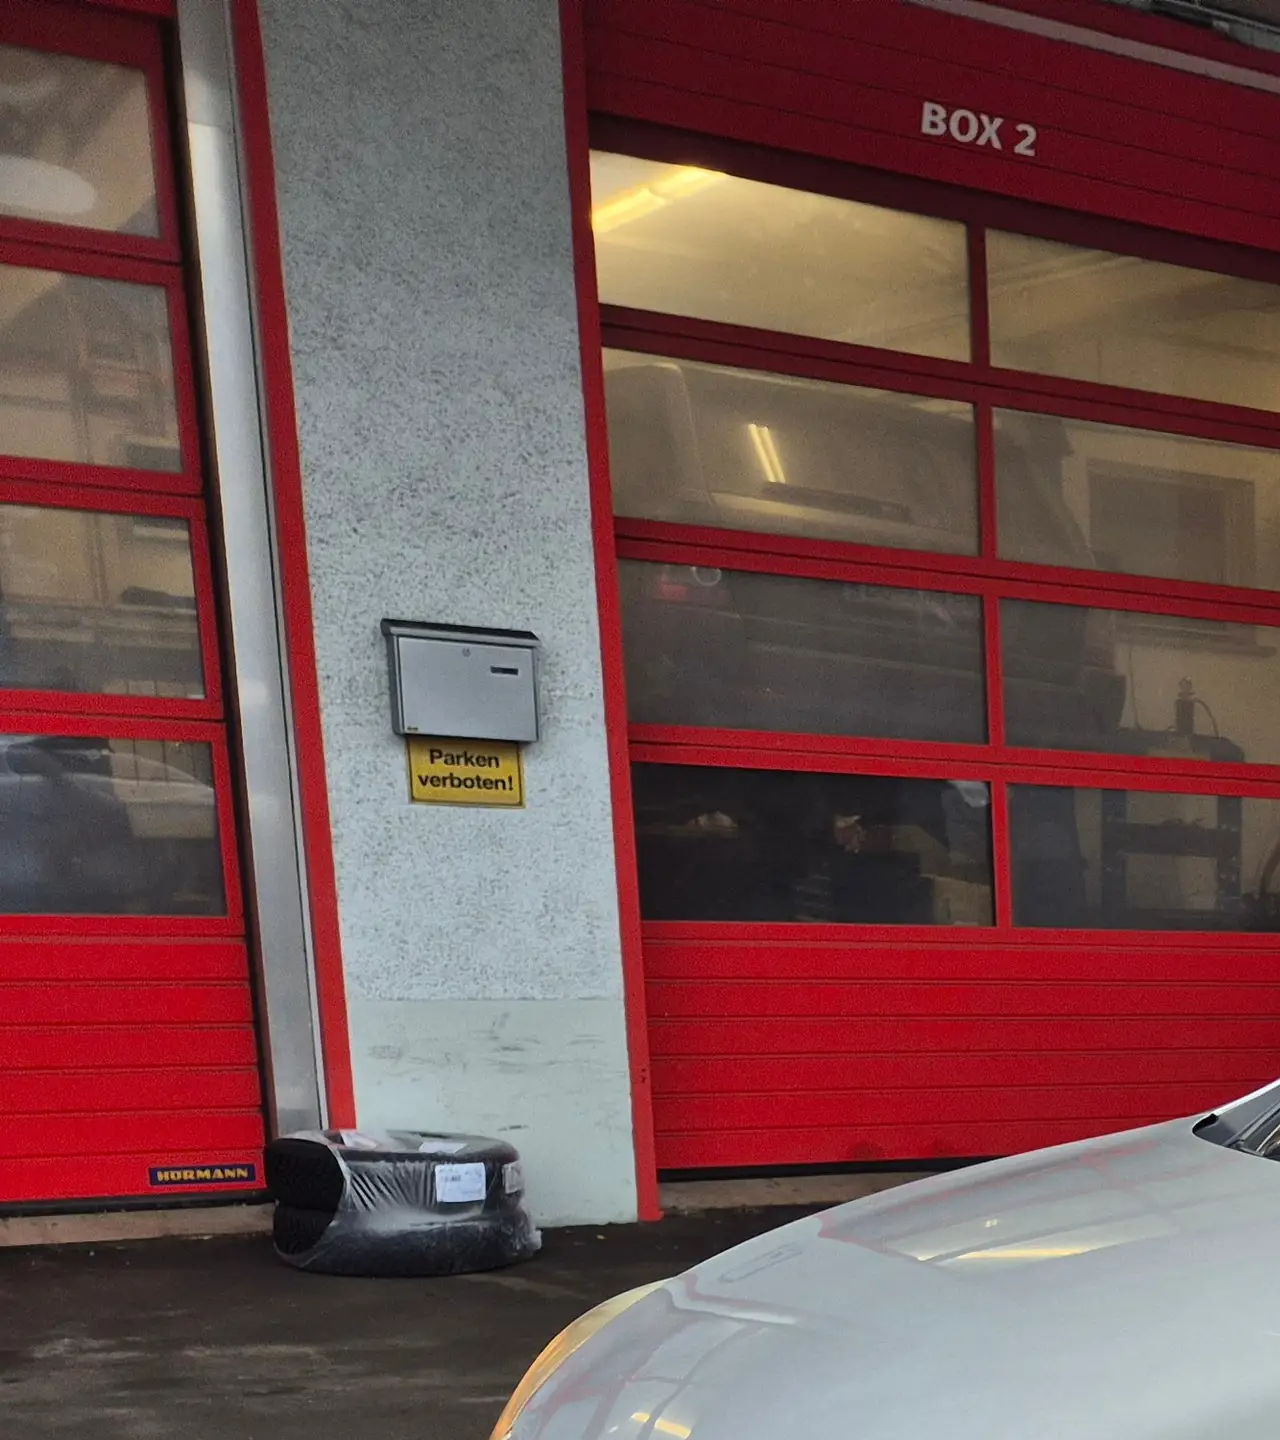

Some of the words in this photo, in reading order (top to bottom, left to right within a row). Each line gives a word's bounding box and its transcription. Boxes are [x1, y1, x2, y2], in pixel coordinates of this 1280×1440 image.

[921, 101, 1005, 151] BOX
[1013, 123, 1038, 157] 2
[429, 748, 500, 769] Parken
[418, 772, 514, 792] verboten!
